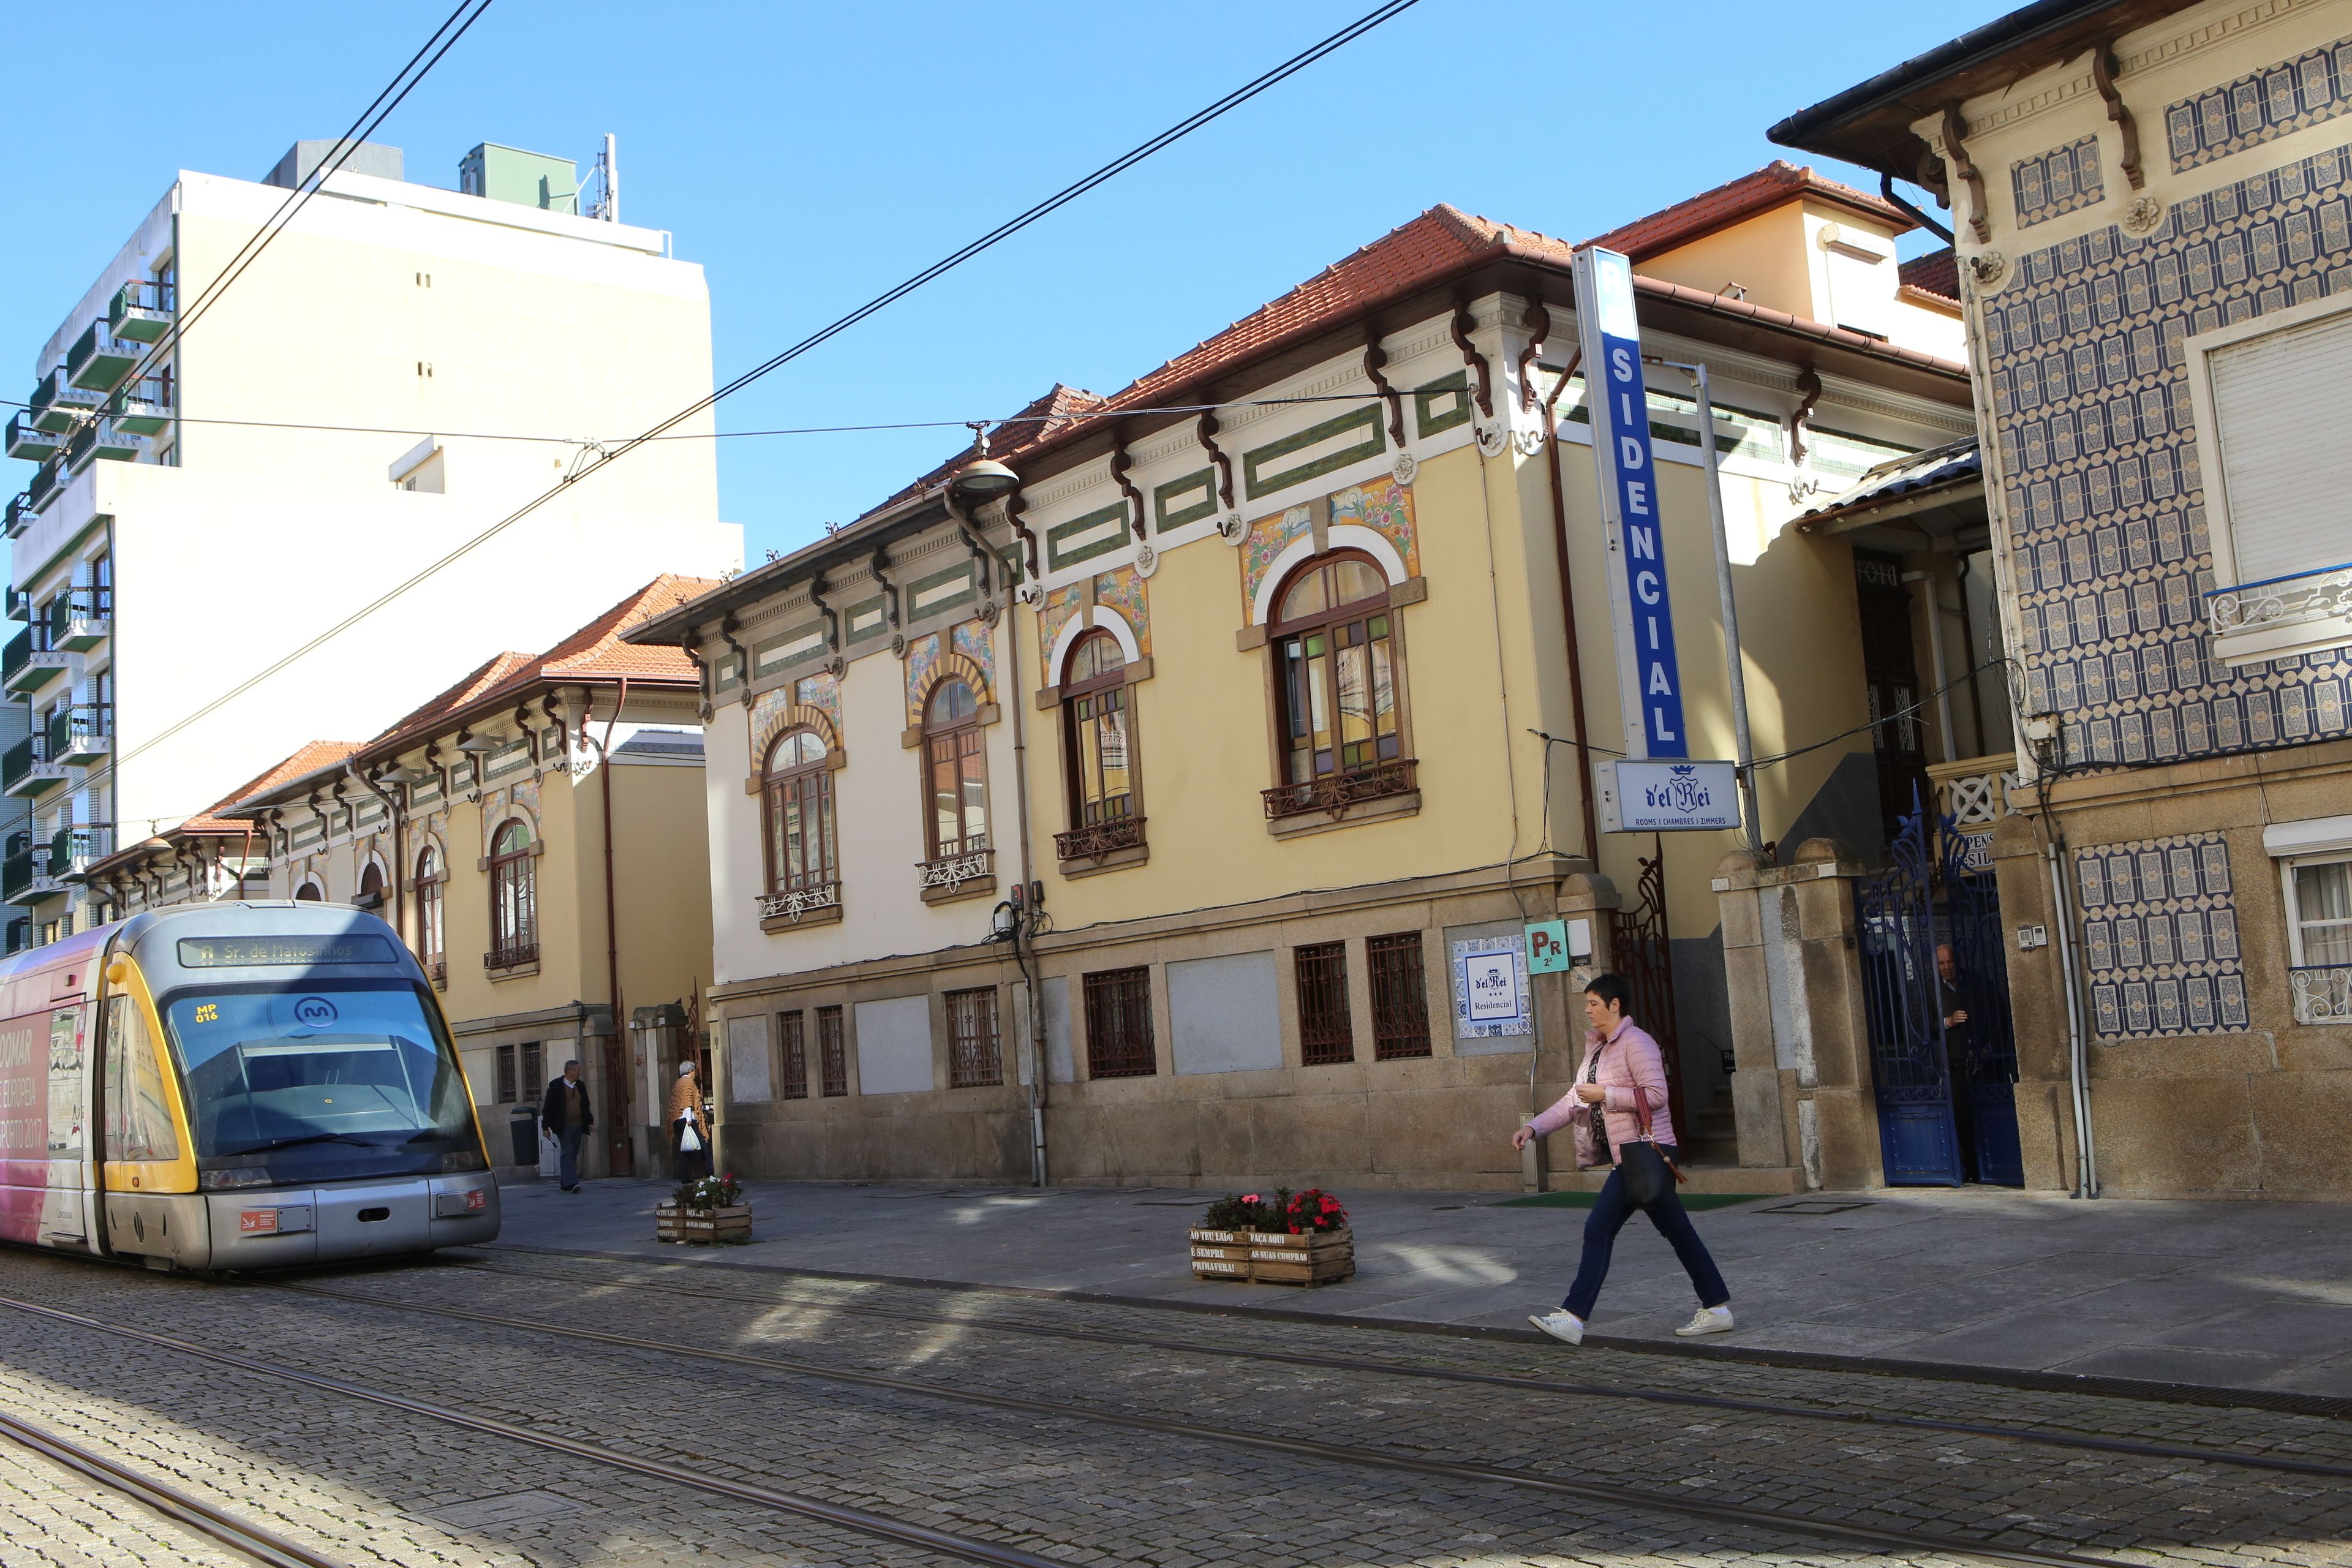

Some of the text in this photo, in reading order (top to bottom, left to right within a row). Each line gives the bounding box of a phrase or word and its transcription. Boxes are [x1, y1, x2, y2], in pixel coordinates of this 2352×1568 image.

[1600, 260, 1675, 741] RSIDENCIAL
[1676, 782, 1711, 807] Rei
[201, 945, 214, 959] A
[225, 945, 244, 958] Sr.
[250, 944, 268, 958] de
[1490, 975, 1507, 987] Rei
[197, 1004, 216, 1014] MP
[1475, 1000, 1512, 1010] Residencial
[195, 1012, 218, 1023] 016
[4, 1076, 36, 1108] EUROPEIA
[25, 1118, 42, 1149] 2017
[1190, 1231, 1234, 1242] AO TEU LADO
[1250, 1234, 1285, 1245] FAÇA AQUI
[1191, 1245, 1224, 1259] É SEMPRE
[1251, 1250, 1308, 1262] AS SUAS COMPRAS
[1192, 1261, 1235, 1273] PRIMAVERA!
